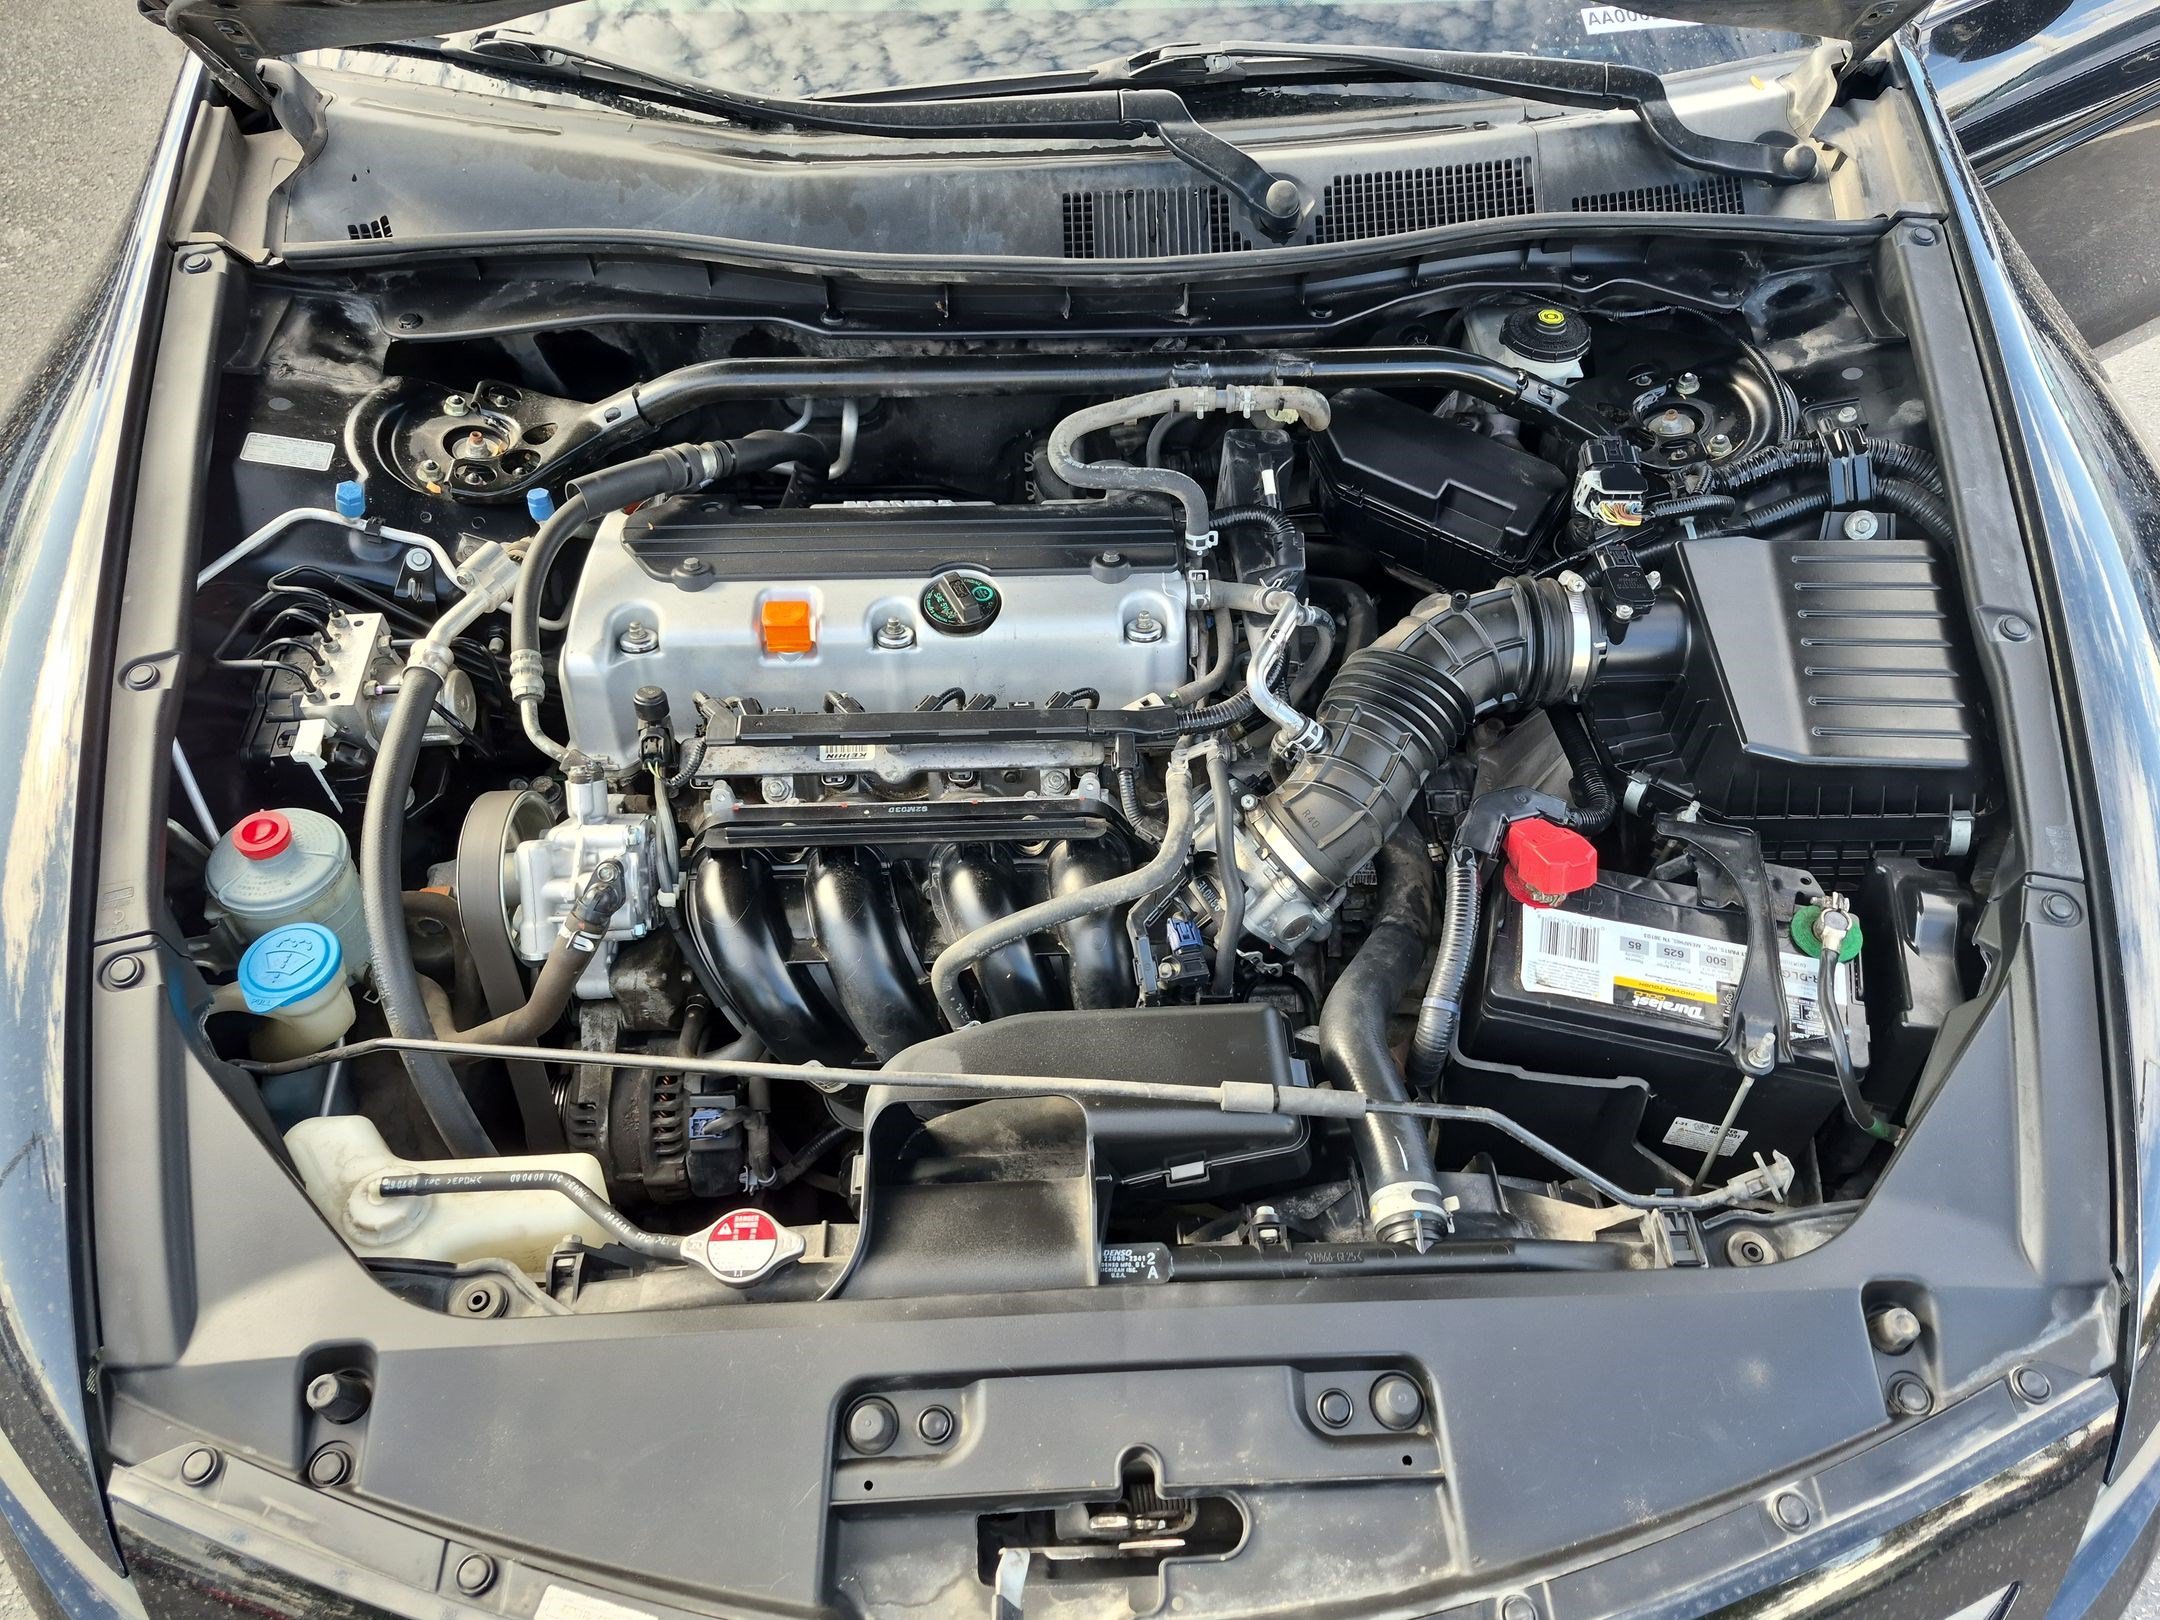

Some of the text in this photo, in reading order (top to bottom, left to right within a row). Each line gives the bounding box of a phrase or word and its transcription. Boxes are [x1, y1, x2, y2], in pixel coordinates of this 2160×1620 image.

[1628, 941, 1642, 950] 85
[1664, 948, 1684, 958] 625
[1706, 956, 1727, 966] 500
[1634, 990, 1666, 1000] GOLD
[1639, 982, 1696, 997] PROVEN TOUGH
[1632, 995, 1705, 1020] Duralast
[1147, 1252, 1156, 1265] 2
[1147, 1265, 1159, 1279] A
